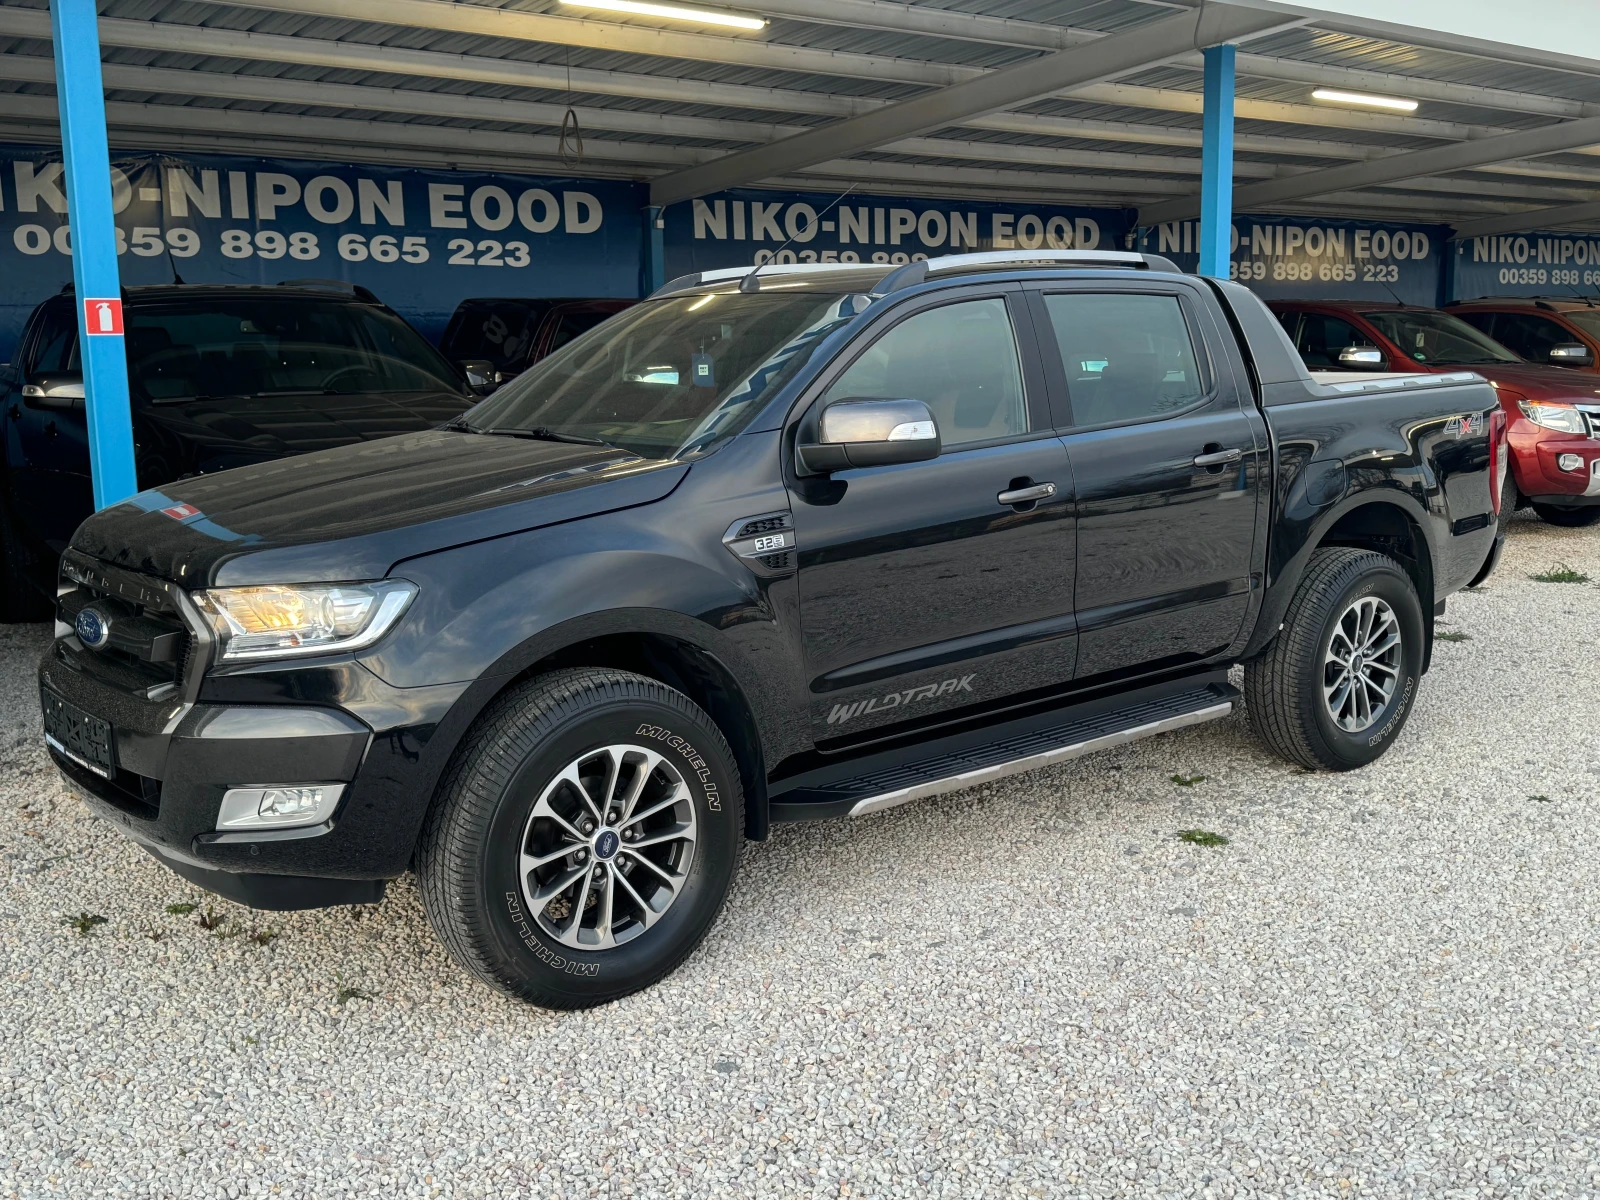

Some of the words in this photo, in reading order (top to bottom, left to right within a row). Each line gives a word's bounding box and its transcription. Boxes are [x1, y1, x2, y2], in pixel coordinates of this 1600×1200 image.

[430, 183, 603, 234] EOOD
[693, 198, 977, 249] NIKO-NIPON
[992, 213, 1099, 250] EOOD
[220, 229, 320, 261] 898
[337, 233, 430, 264] 665
[447, 240, 531, 268] 223
[1158, 220, 1345, 257] NI-NIPON
[1354, 229, 1430, 260] EOOD
[1473, 236, 1600, 265] NIKO-NIPON
[1196, 261, 1266, 280] 359
[1273, 262, 1313, 281] 898
[1318, 263, 1357, 282] 665
[1363, 265, 1399, 283] 223
[1499, 268, 1548, 285] 00359
[1551, 269, 1580, 286] 898
[826, 673, 978, 725] WILDTRAK
[1368, 676, 1414, 747] MICHELIN
[635, 723, 722, 812] MICHELIN
[505, 891, 601, 977] MICHELIN
